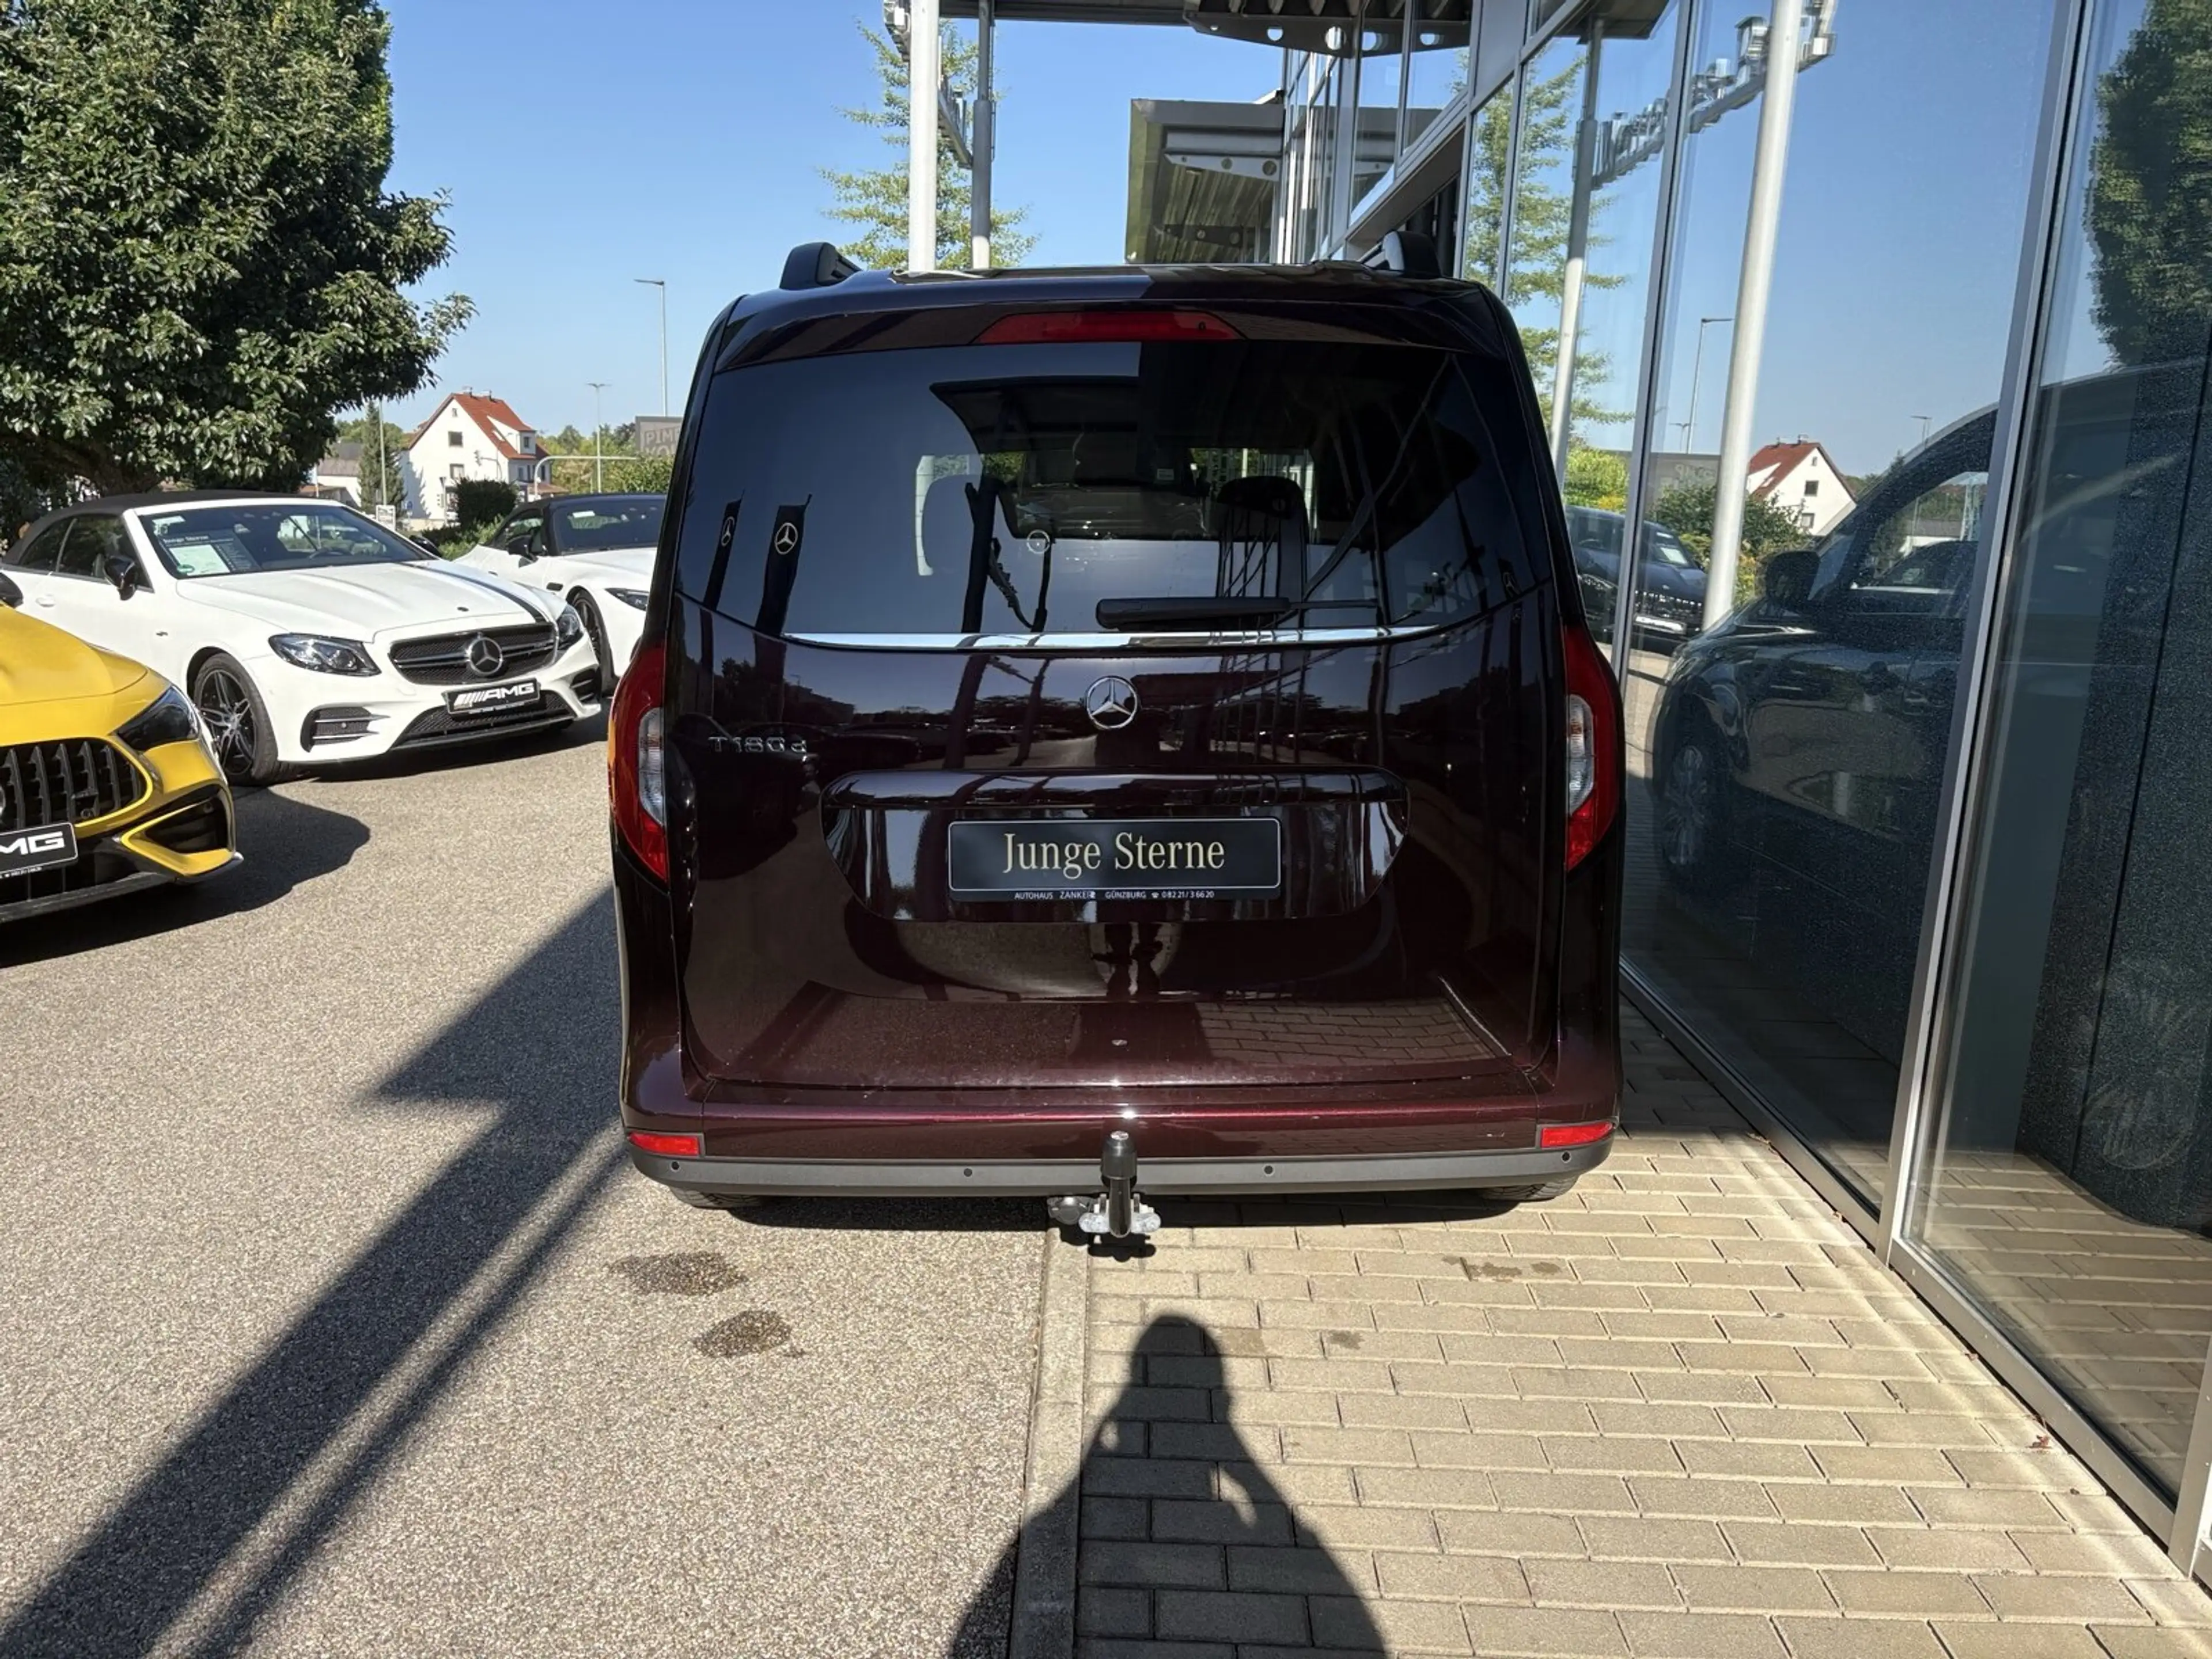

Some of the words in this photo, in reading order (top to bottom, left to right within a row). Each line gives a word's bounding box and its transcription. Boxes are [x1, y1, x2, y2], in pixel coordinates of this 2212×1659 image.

[483, 683, 535, 702] AMG
[1002, 833, 1101, 880] Junge
[1115, 832, 1225, 869] Sterne
[1014, 892, 1053, 900] AUTOHAUS
[1105, 891, 1147, 899] GÜNZBURG
